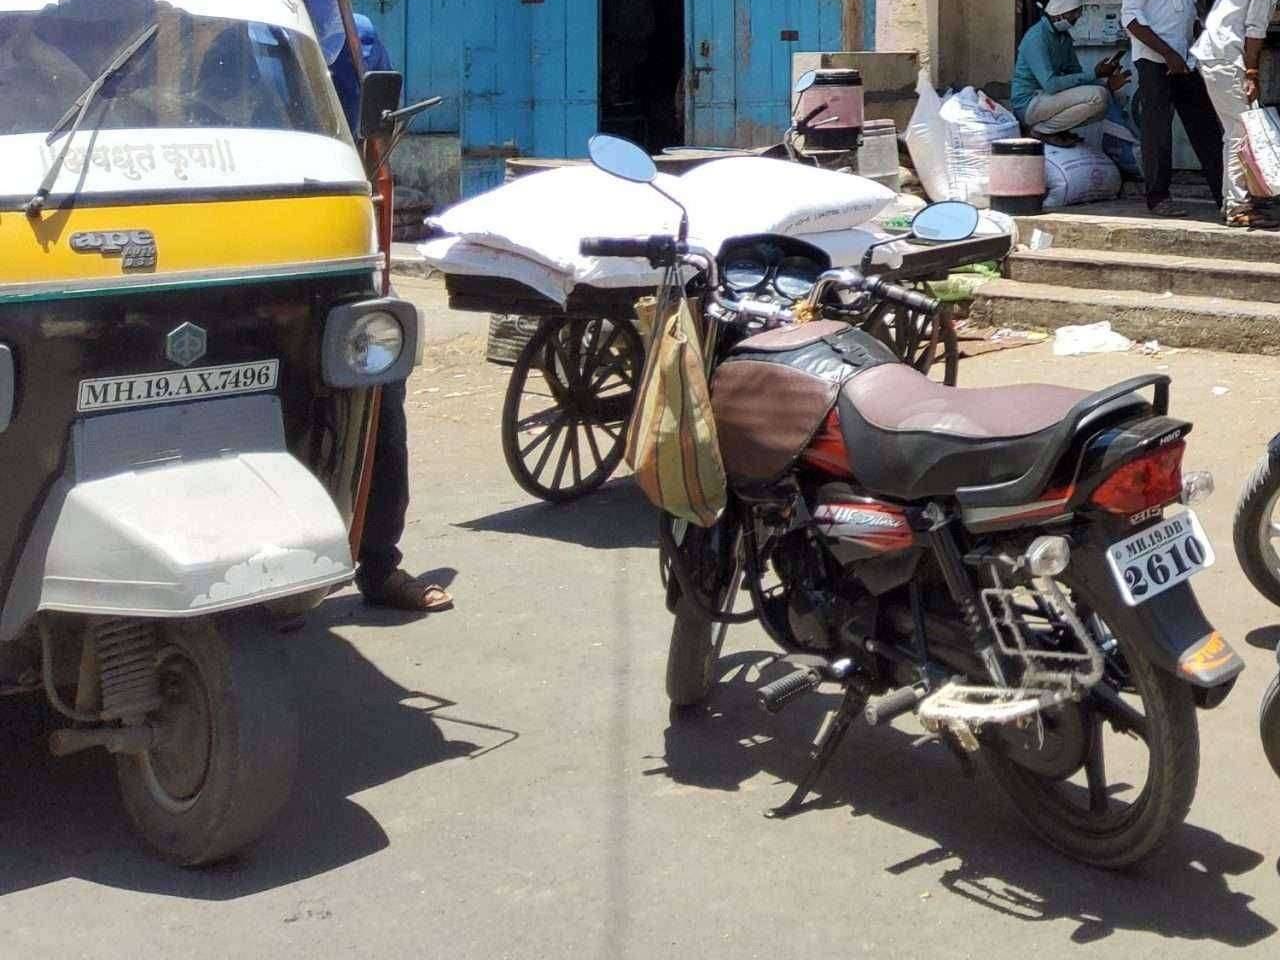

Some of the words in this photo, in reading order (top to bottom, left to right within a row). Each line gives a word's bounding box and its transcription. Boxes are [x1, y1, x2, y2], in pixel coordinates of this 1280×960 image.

[84, 365, 270, 406] MH.19.AX.7496
[1125, 519, 1184, 557] MH.19.DB
[1124, 535, 1207, 596] 2610
